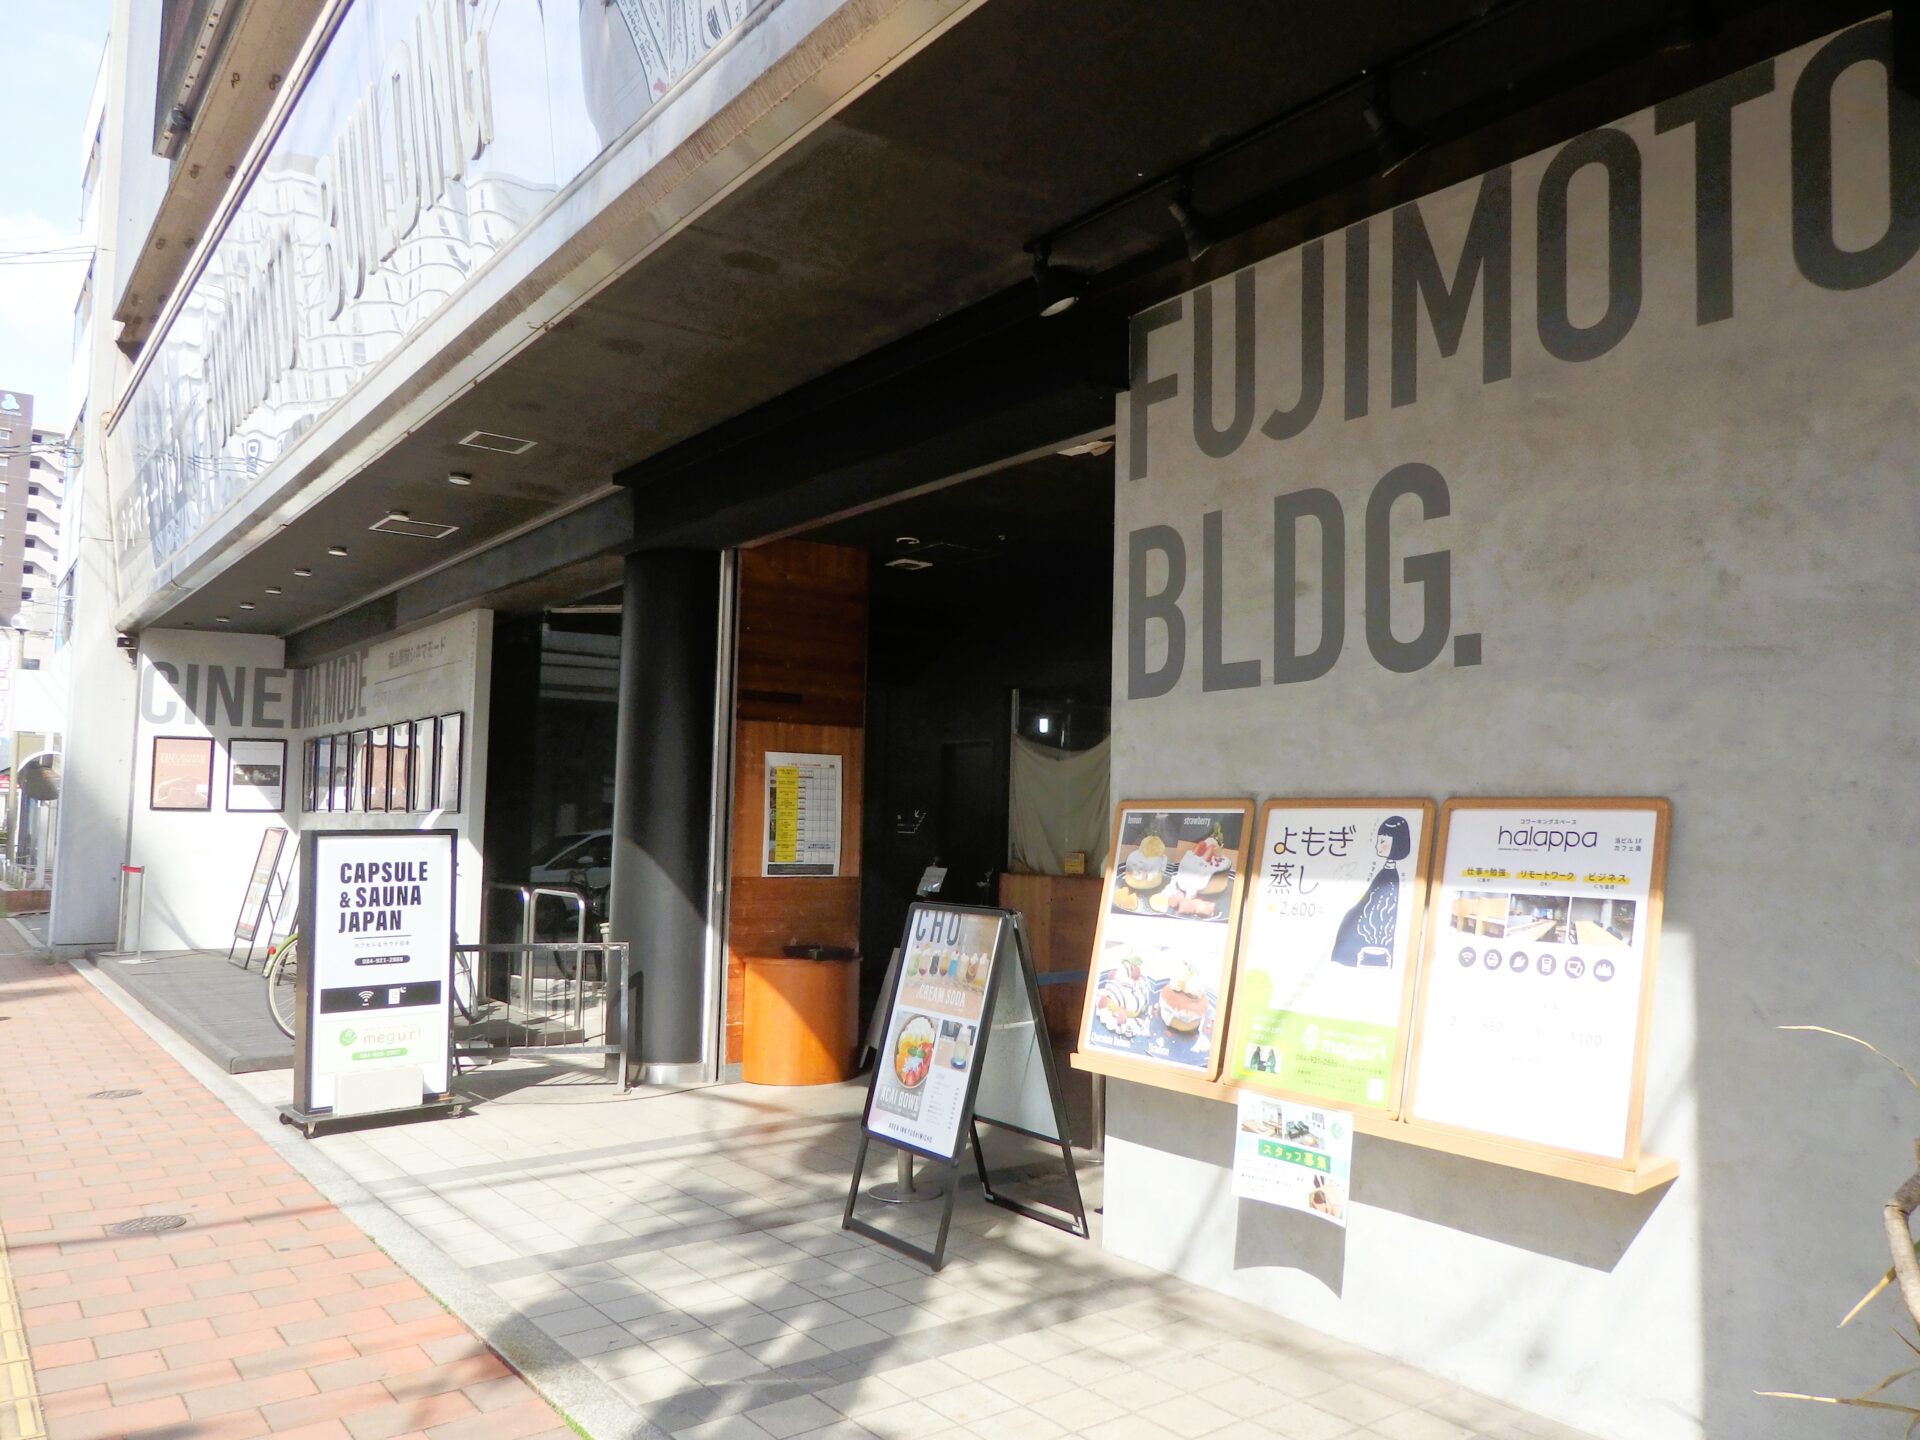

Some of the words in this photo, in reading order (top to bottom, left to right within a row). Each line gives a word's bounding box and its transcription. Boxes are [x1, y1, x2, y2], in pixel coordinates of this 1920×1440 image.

[1129, 18, 1920, 482] FUJIMOTO
[1127, 462, 1482, 700] BLDG.
[140, 660, 321, 731] CINEMA
[323, 647, 370, 724] MODE
[1184, 816, 1211, 827] strawberry
[1273, 824, 1357, 857] よもぎ
[1498, 826, 1598, 852] halappa
[340, 861, 428, 884] CAPSULE
[1267, 862, 1319, 895] 蒸し
[1520, 869, 1575, 881] リモートワーク
[1587, 872, 1627, 883] ビジネス
[339, 891, 351, 908] &
[355, 885, 422, 907] SAUNA
[338, 910, 402, 933] JAPAN
[919, 984, 945, 1003] CREAM
[945, 989, 966, 1008] SODA
[363, 1027, 423, 1046] meguri
[880, 1086, 897, 1105] ACAI
[898, 1091, 919, 1111] BOWL
[1263, 1144, 1328, 1171] スタッフ募集
